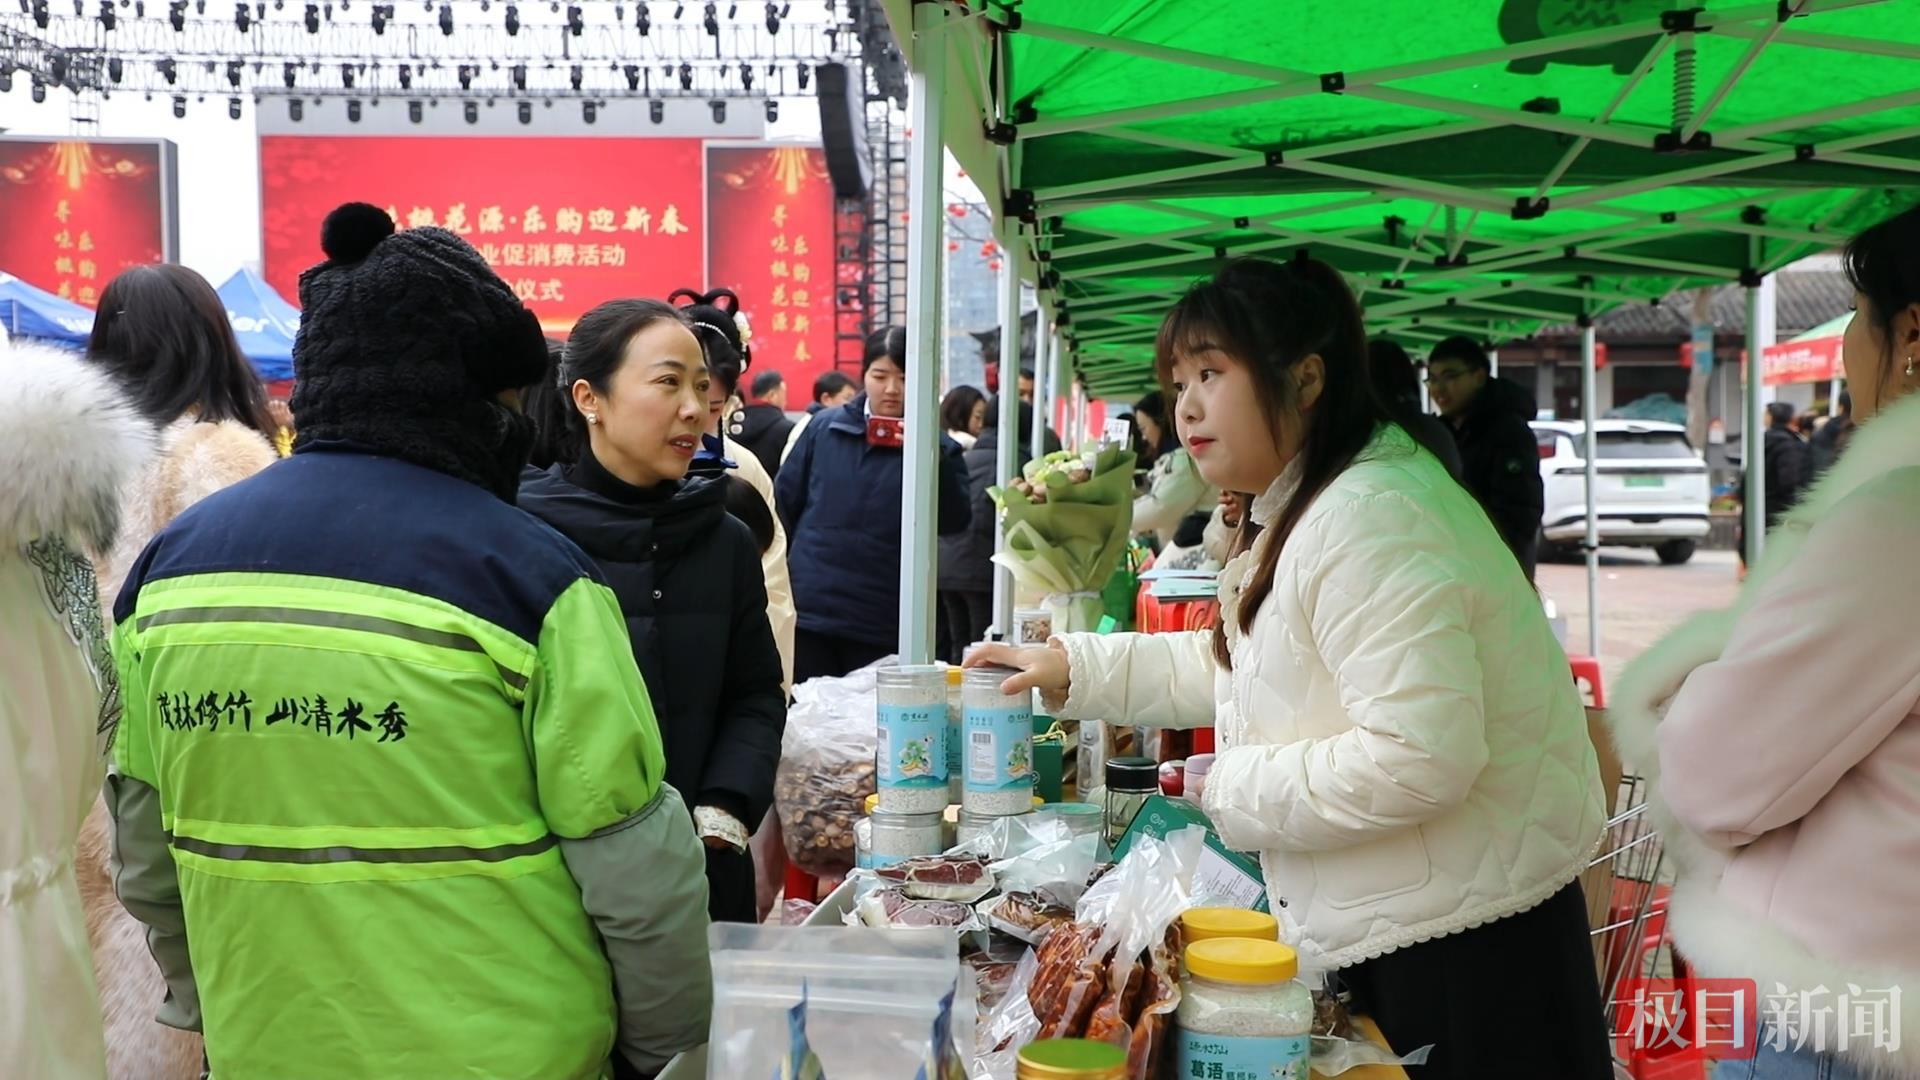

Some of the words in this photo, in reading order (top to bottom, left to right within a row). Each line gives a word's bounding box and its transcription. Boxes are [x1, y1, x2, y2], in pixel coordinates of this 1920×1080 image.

[771, 203, 789, 332] 寻味桃花源
[793, 234, 811, 362] 乐购迎新春
[157, 690, 253, 732] 茂林修竹
[265, 694, 409, 742] 山清水秀
[1191, 1060, 1223, 1079] 葛语
